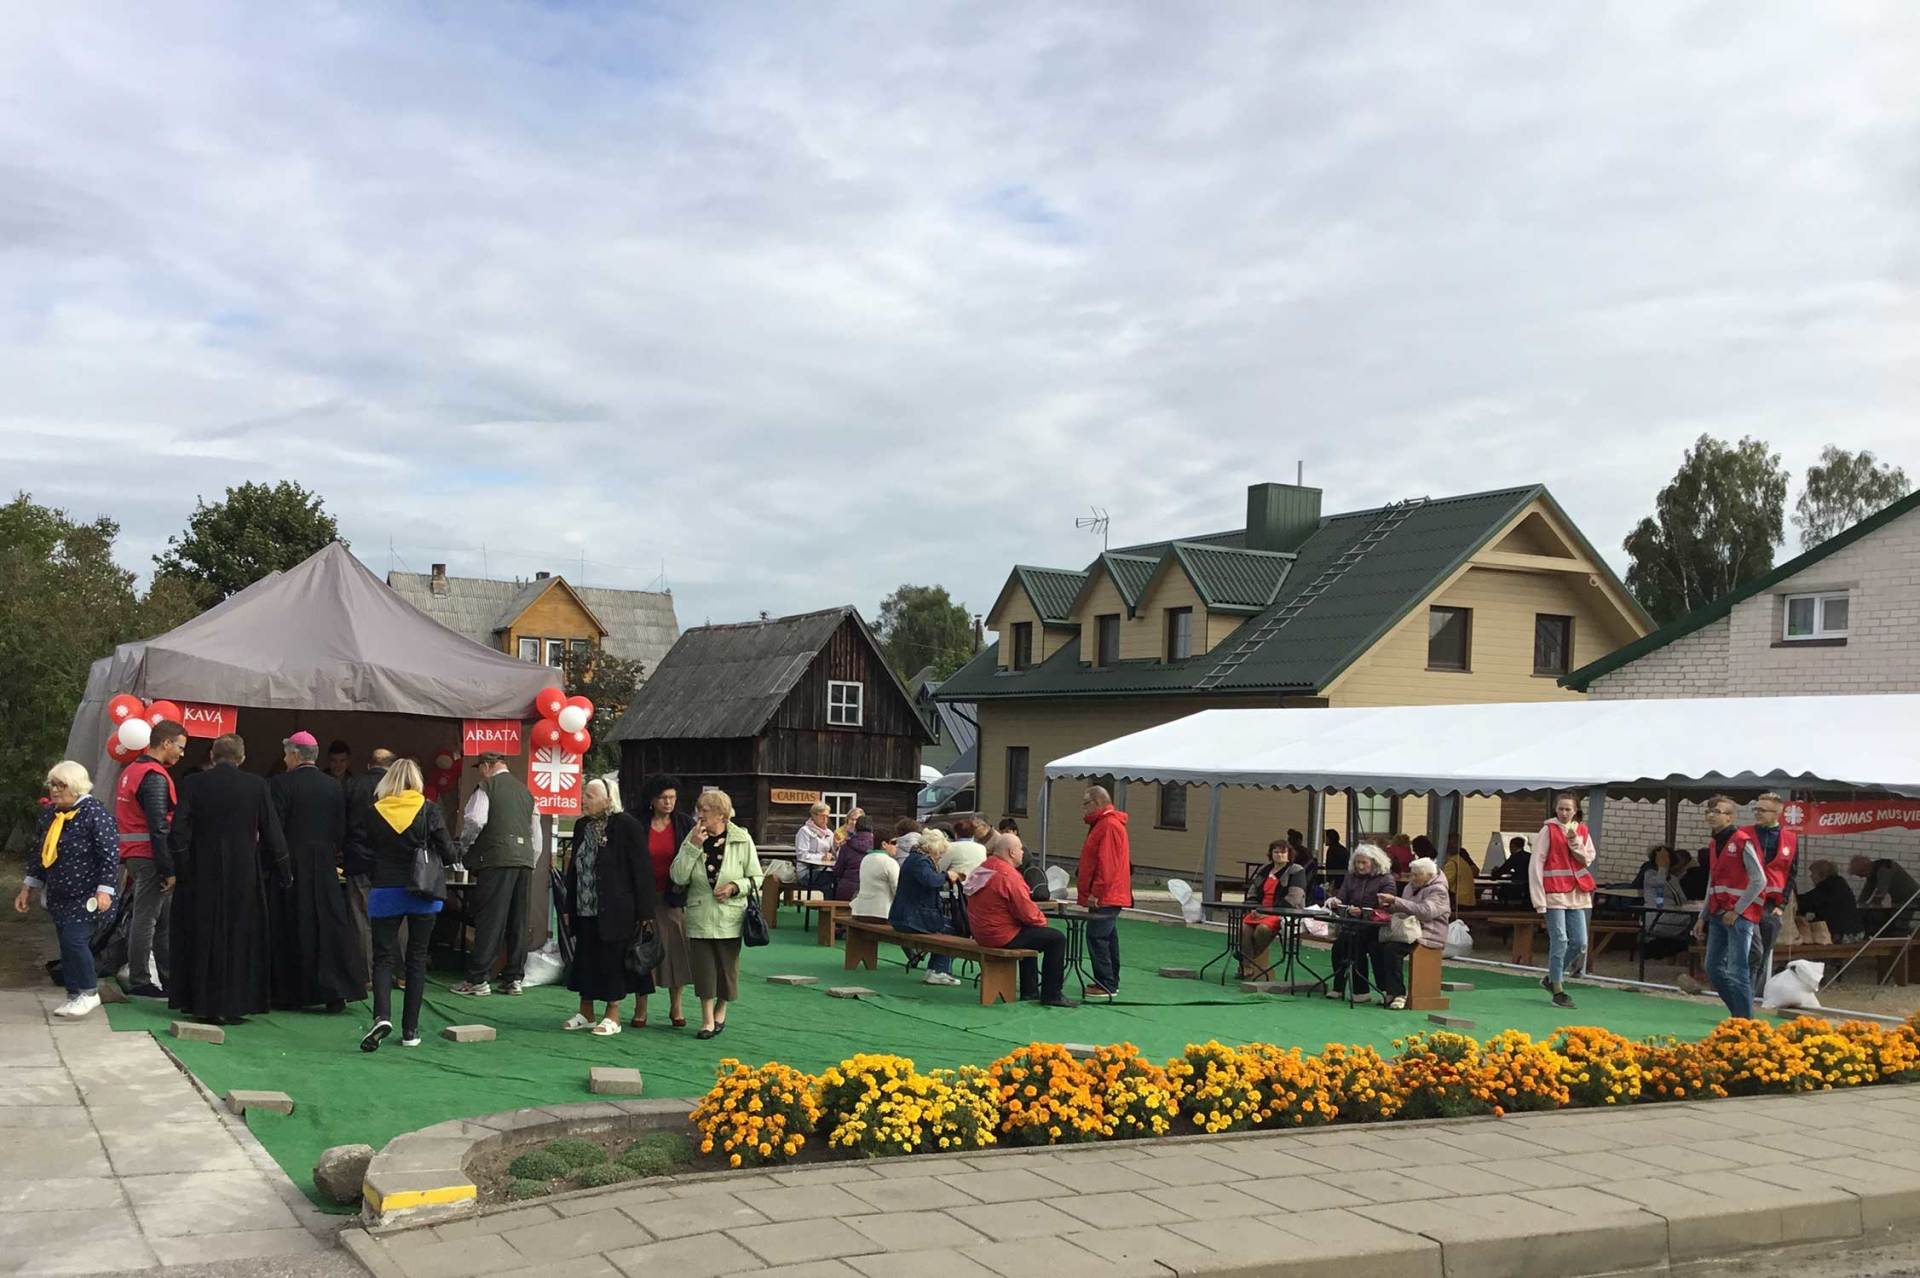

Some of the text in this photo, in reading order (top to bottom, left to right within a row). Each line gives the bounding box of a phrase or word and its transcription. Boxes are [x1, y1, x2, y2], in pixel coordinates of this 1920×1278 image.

[184, 707, 224, 724] KAVA
[465, 729, 519, 741] ARBATA
[776, 791, 817, 802] CARITAS
[1819, 810, 1873, 827] GERUMAS
